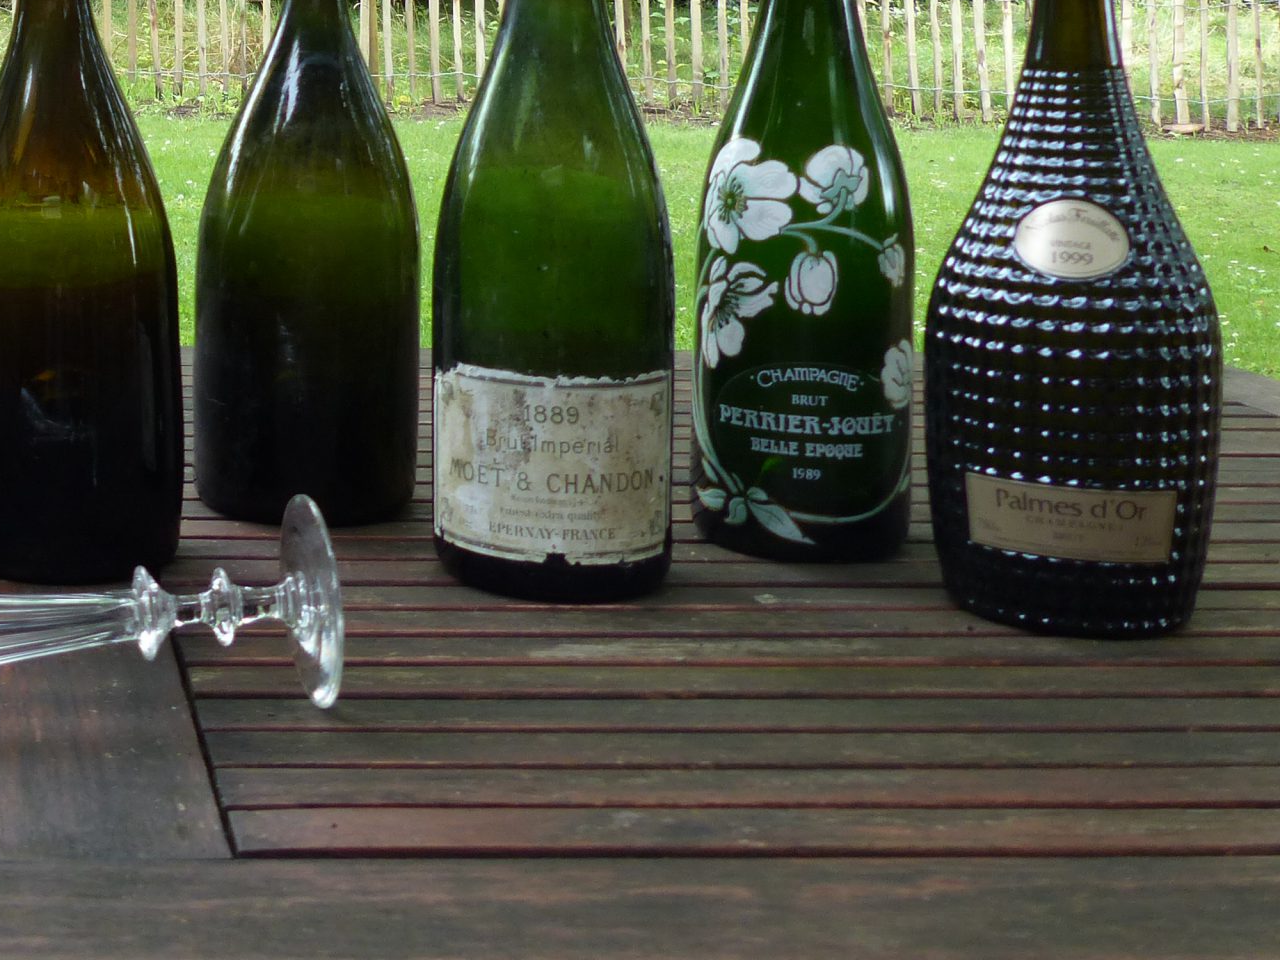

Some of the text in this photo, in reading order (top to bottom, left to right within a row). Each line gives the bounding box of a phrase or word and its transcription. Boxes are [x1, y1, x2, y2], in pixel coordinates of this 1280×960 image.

[1052, 251, 1094, 265] 1999
[756, 367, 860, 391] CHAMPAGNE
[791, 394, 829, 406] BRUT
[523, 405, 579, 425] 1889
[750, 437, 864, 460] BELLE EPOQUE
[517, 474, 532, 491] &
[546, 468, 654, 494] CHANDON
[792, 468, 821, 480] 1989
[995, 488, 1147, 521] Palmes d'Or
